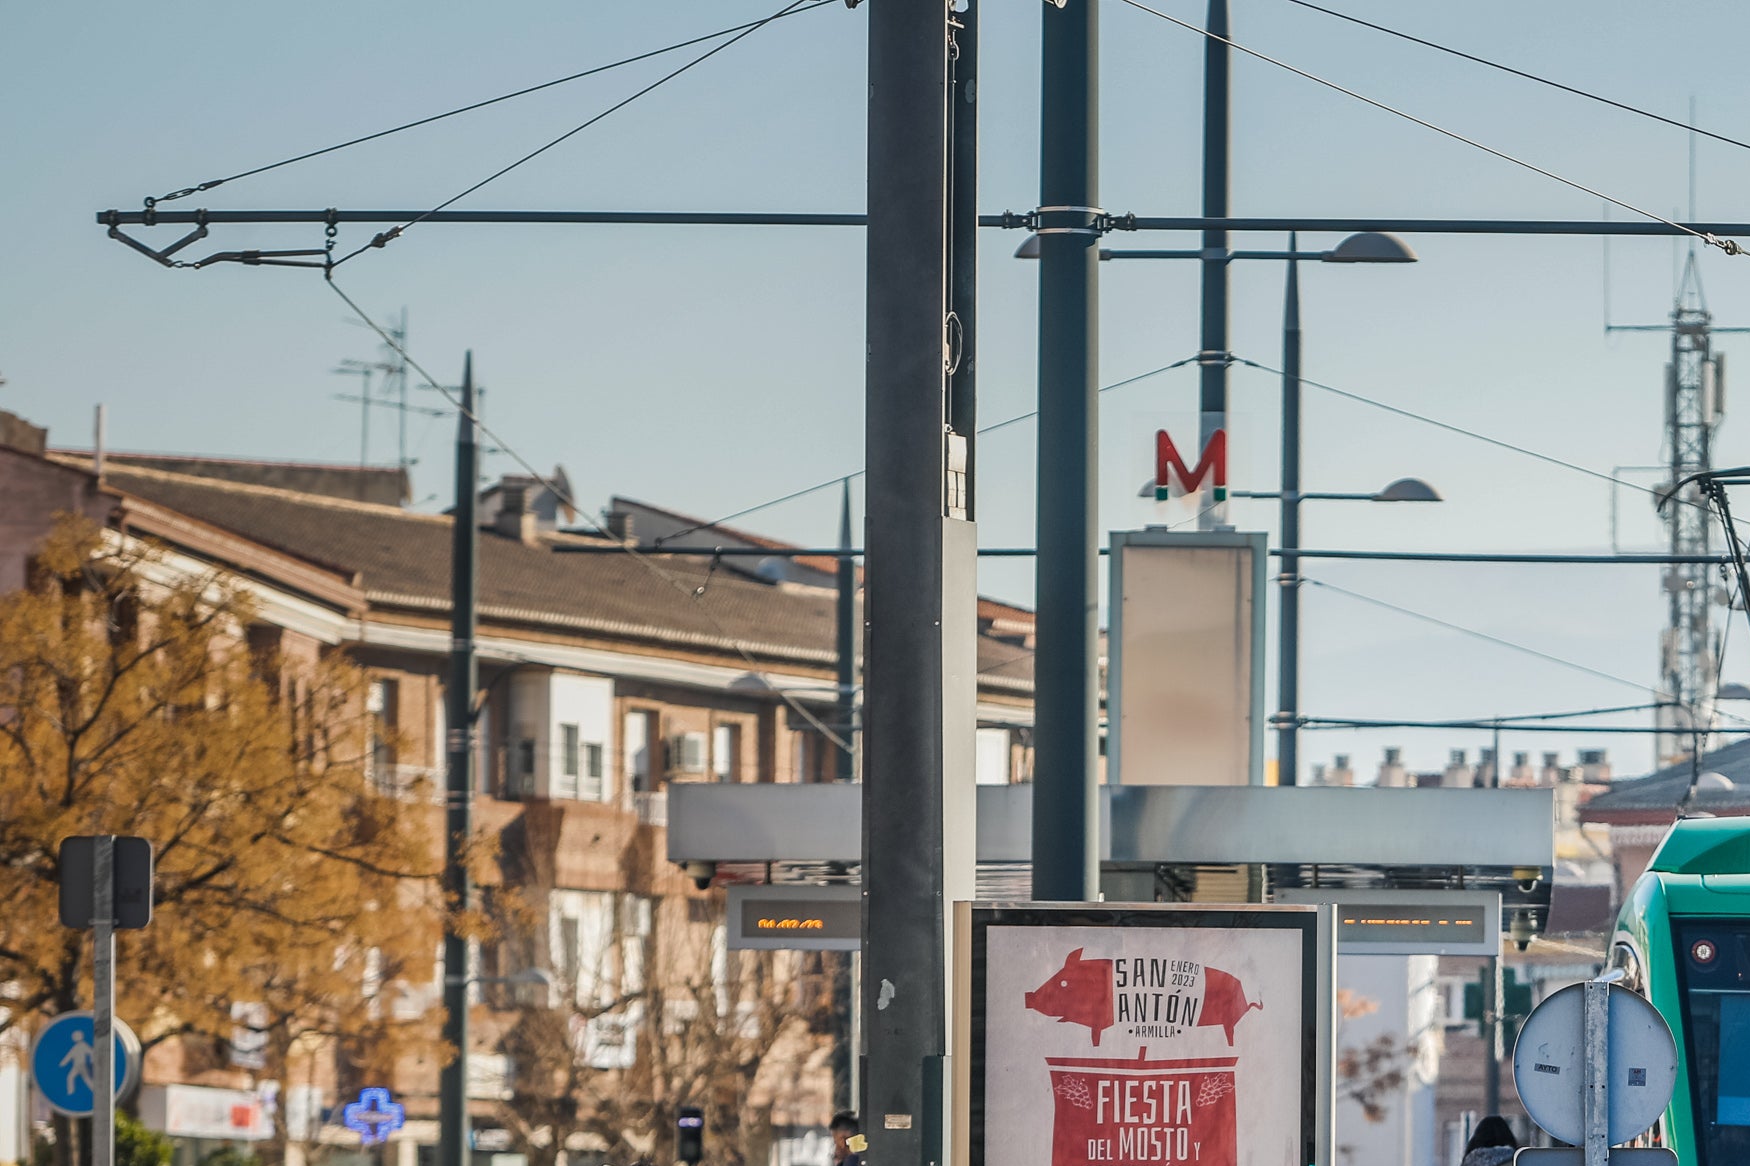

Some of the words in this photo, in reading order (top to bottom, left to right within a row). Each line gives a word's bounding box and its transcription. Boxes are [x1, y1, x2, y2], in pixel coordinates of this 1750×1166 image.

[1155, 428, 1227, 501] M
[1115, 958, 1167, 988] SAN
[1170, 960, 1200, 976] ENERO
[1171, 973, 1195, 988] 2023
[1118, 989, 1198, 1027] ANTÓN
[1135, 1025, 1176, 1038] ARMILLA
[1096, 1080, 1193, 1125] FIESTA
[1087, 1138, 1113, 1161] DEL
[1118, 1126, 1188, 1161] MOSTO
[1193, 1141, 1201, 1161] Y
